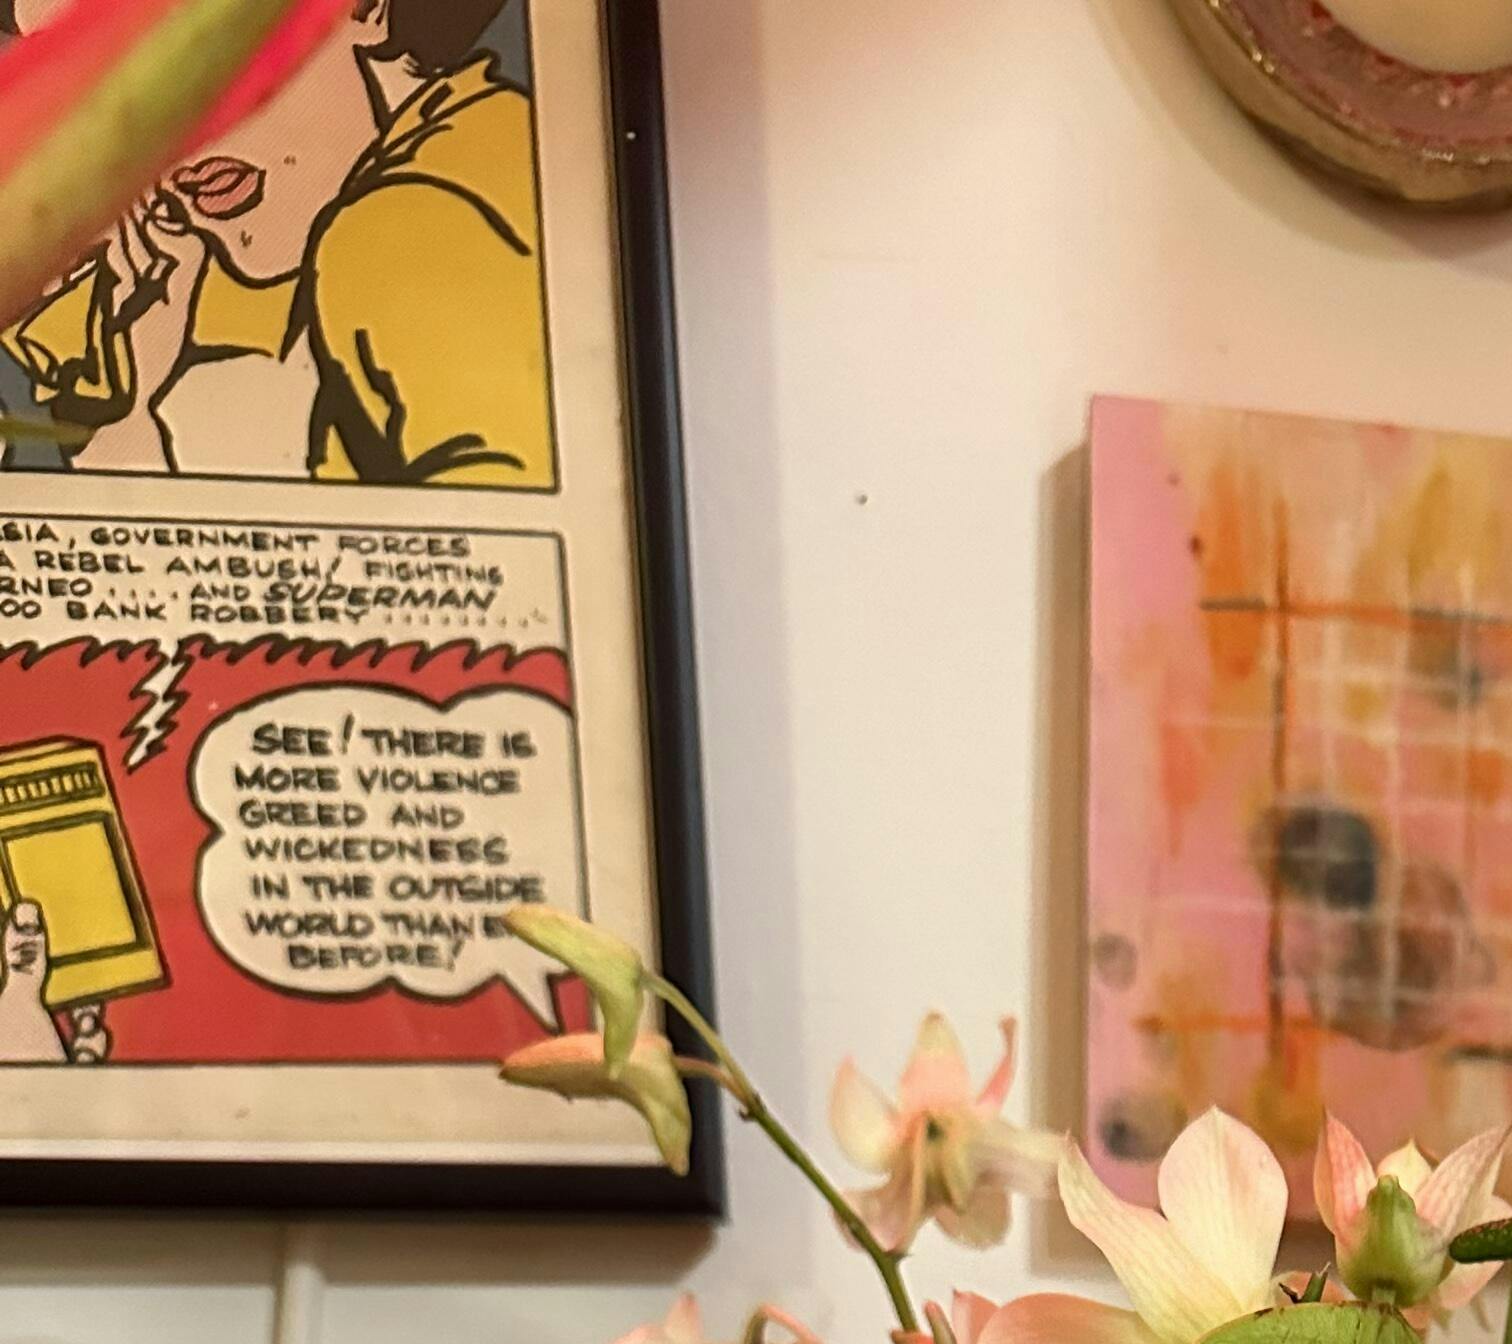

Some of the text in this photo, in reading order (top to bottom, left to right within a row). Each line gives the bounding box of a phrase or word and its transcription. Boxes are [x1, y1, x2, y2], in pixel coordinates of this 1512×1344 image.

[91, 527, 320, 551] GOVERNMENT
[337, 533, 471, 557] FORCES
[35, 550, 144, 573] REBEL
[166, 555, 341, 584] AMBUSH!
[363, 559, 504, 587] FIGHTING
[191, 582, 251, 601] AND
[264, 581, 498, 611] SUPERMAN
[66, 600, 167, 621] BANK
[191, 604, 370, 625] ROBBERY
[250, 712, 537, 758] SEE! THERE IS
[234, 764, 520, 795] MORE VIOLENCE
[238, 798, 465, 829] GREED AND
[243, 837, 510, 865] WICKEDNESS
[251, 874, 545, 903] IN THE OUTSIDE
[244, 911, 375, 939] WORLD
[381, 912, 475, 937] THAN
[288, 940, 465, 971] BEFORE!
